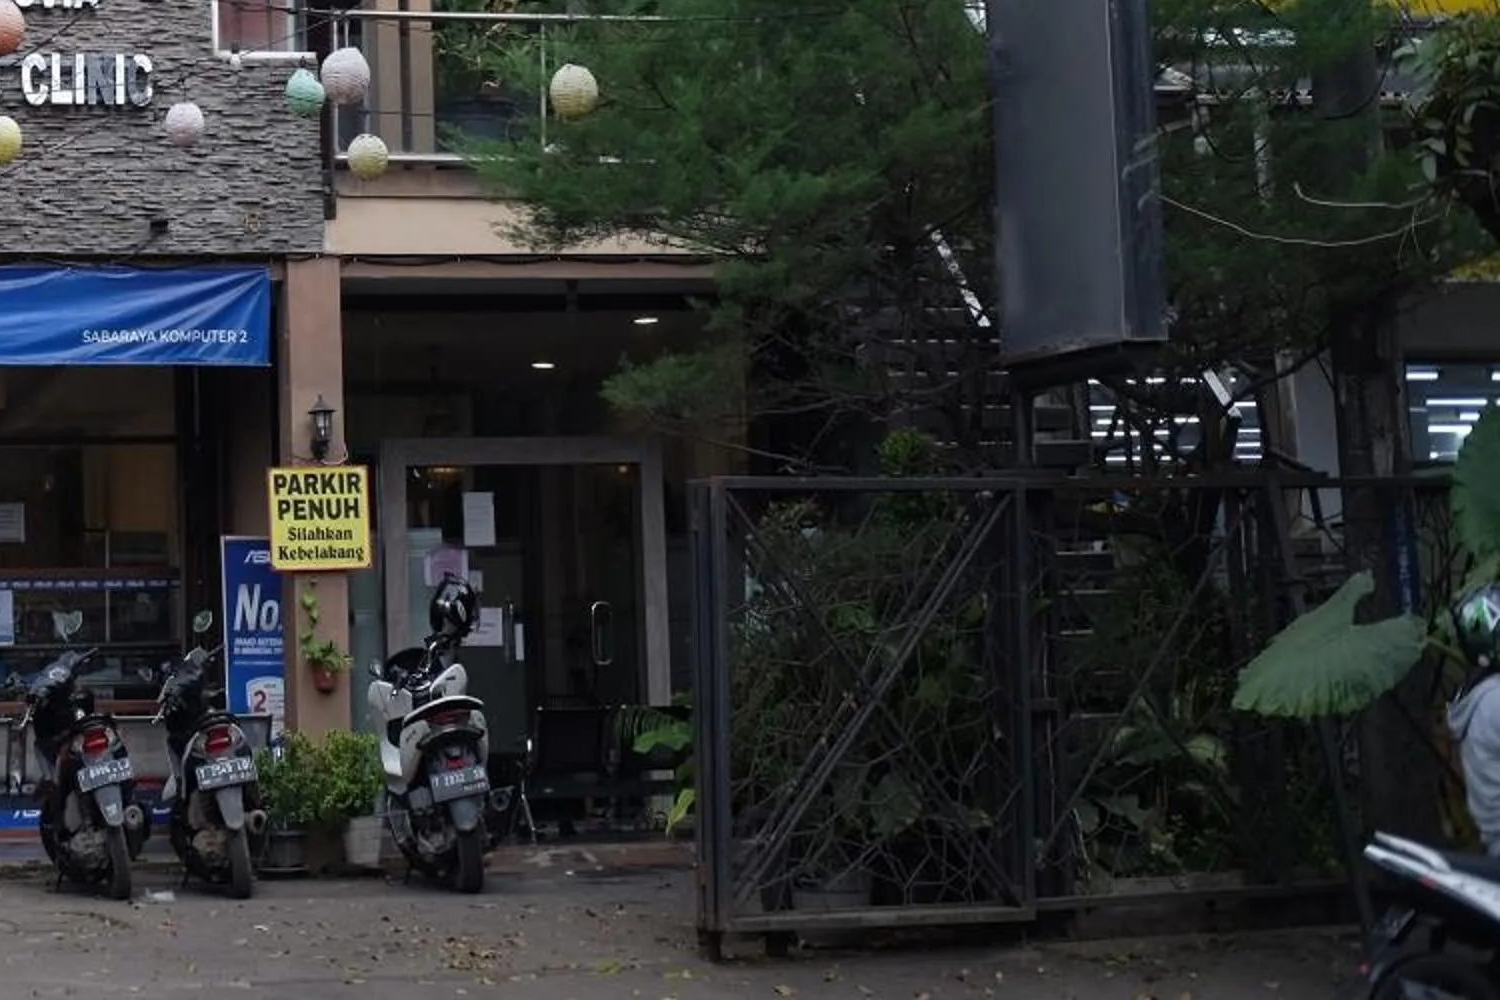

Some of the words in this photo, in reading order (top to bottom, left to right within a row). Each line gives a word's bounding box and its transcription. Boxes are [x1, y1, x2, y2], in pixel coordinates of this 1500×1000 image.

[21, 53, 153, 105] CLINIC
[83, 329, 156, 343] SABARAYA
[159, 329, 236, 344] KOMPUTER
[239, 330, 248, 343] 2
[273, 472, 361, 495] PARKIR
[278, 498, 360, 520] PENUH
[288, 527, 353, 541] Silahkan
[278, 545, 365, 561] Kebelakang
[253, 689, 267, 713] 2
